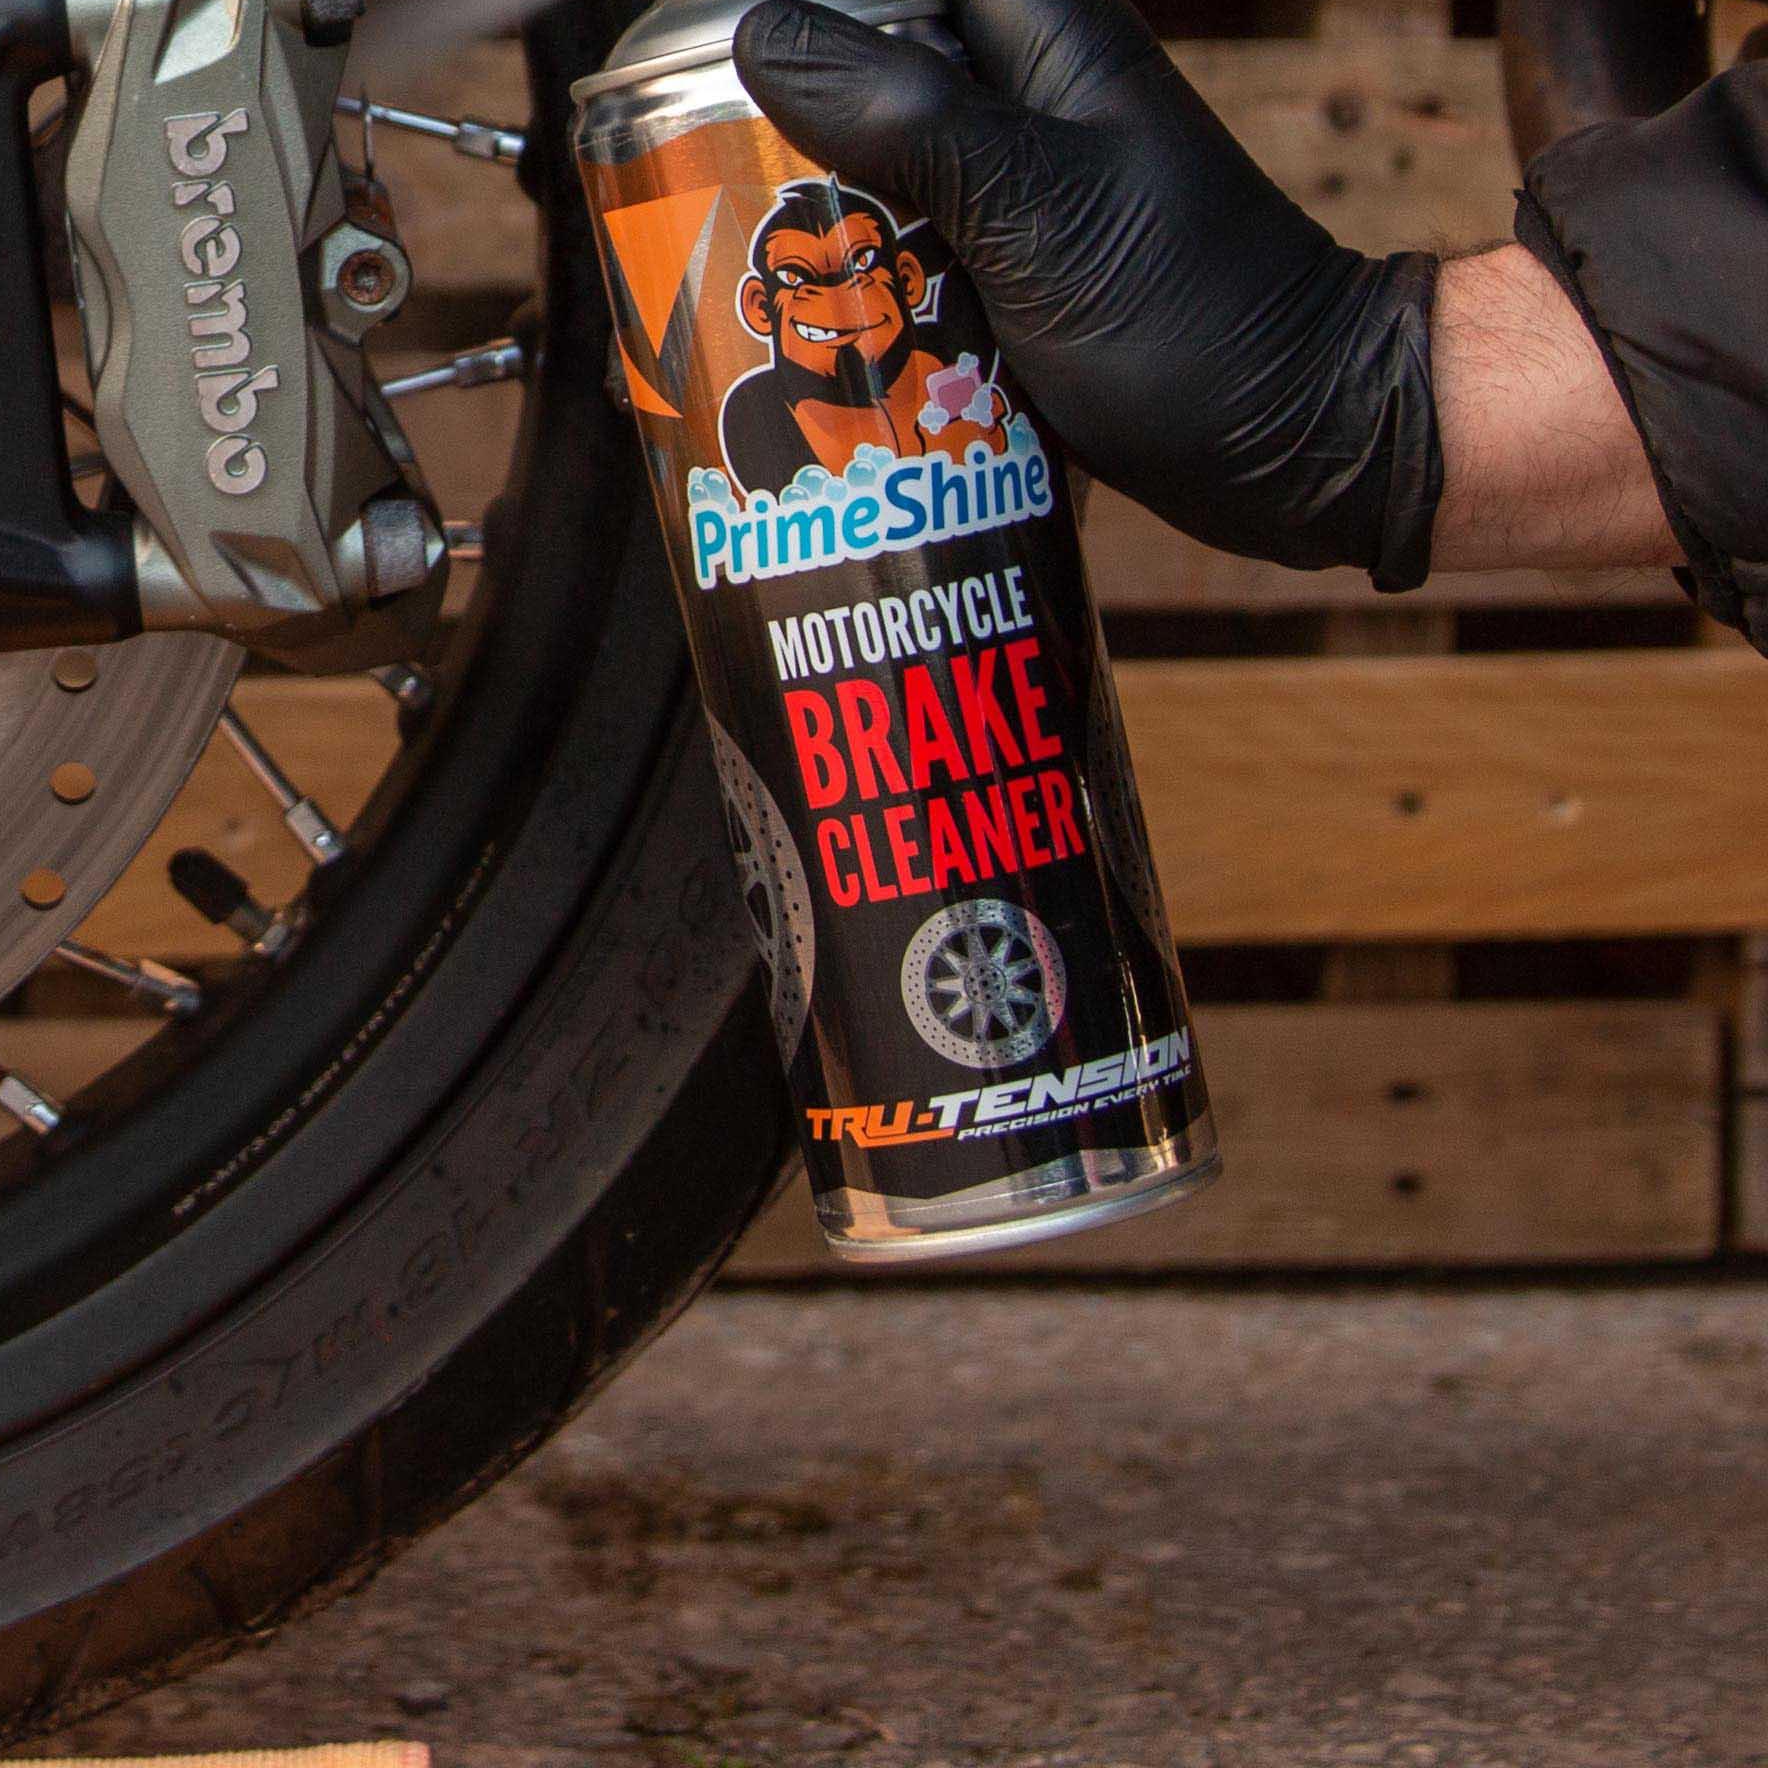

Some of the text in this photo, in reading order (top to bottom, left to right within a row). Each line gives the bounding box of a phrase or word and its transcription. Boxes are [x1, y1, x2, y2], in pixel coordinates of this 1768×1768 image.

[164, 107, 279, 496] brembo
[694, 449, 1048, 581] PrimeShine
[768, 567, 1033, 682] MOTORCYCLE
[784, 638, 1063, 811] BRAKE
[815, 770, 1085, 908] CLEANER
[806, 1026, 1191, 1149] TRU-TENSION
[957, 1101, 1090, 1141] PRECISION
